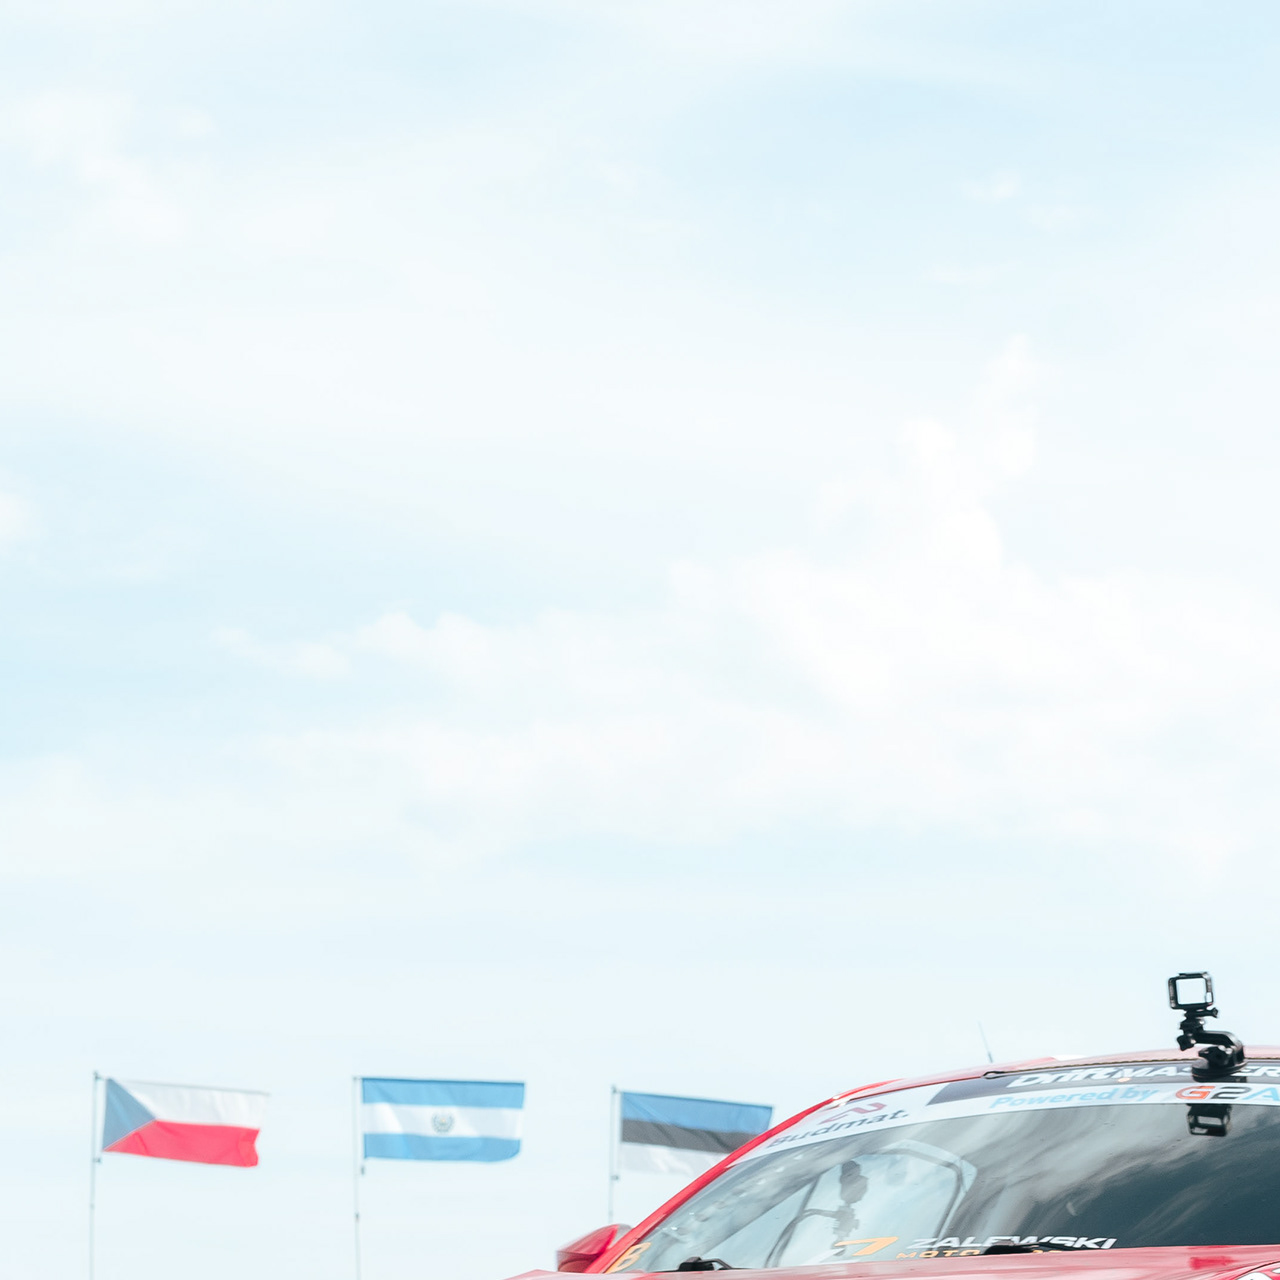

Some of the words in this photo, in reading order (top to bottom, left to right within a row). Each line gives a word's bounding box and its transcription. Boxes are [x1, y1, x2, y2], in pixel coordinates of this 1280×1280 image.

[989, 1086, 1121, 1109] Powered
[1122, 1086, 1159, 1103] by
[1175, 1085, 1280, 1102] G2A
